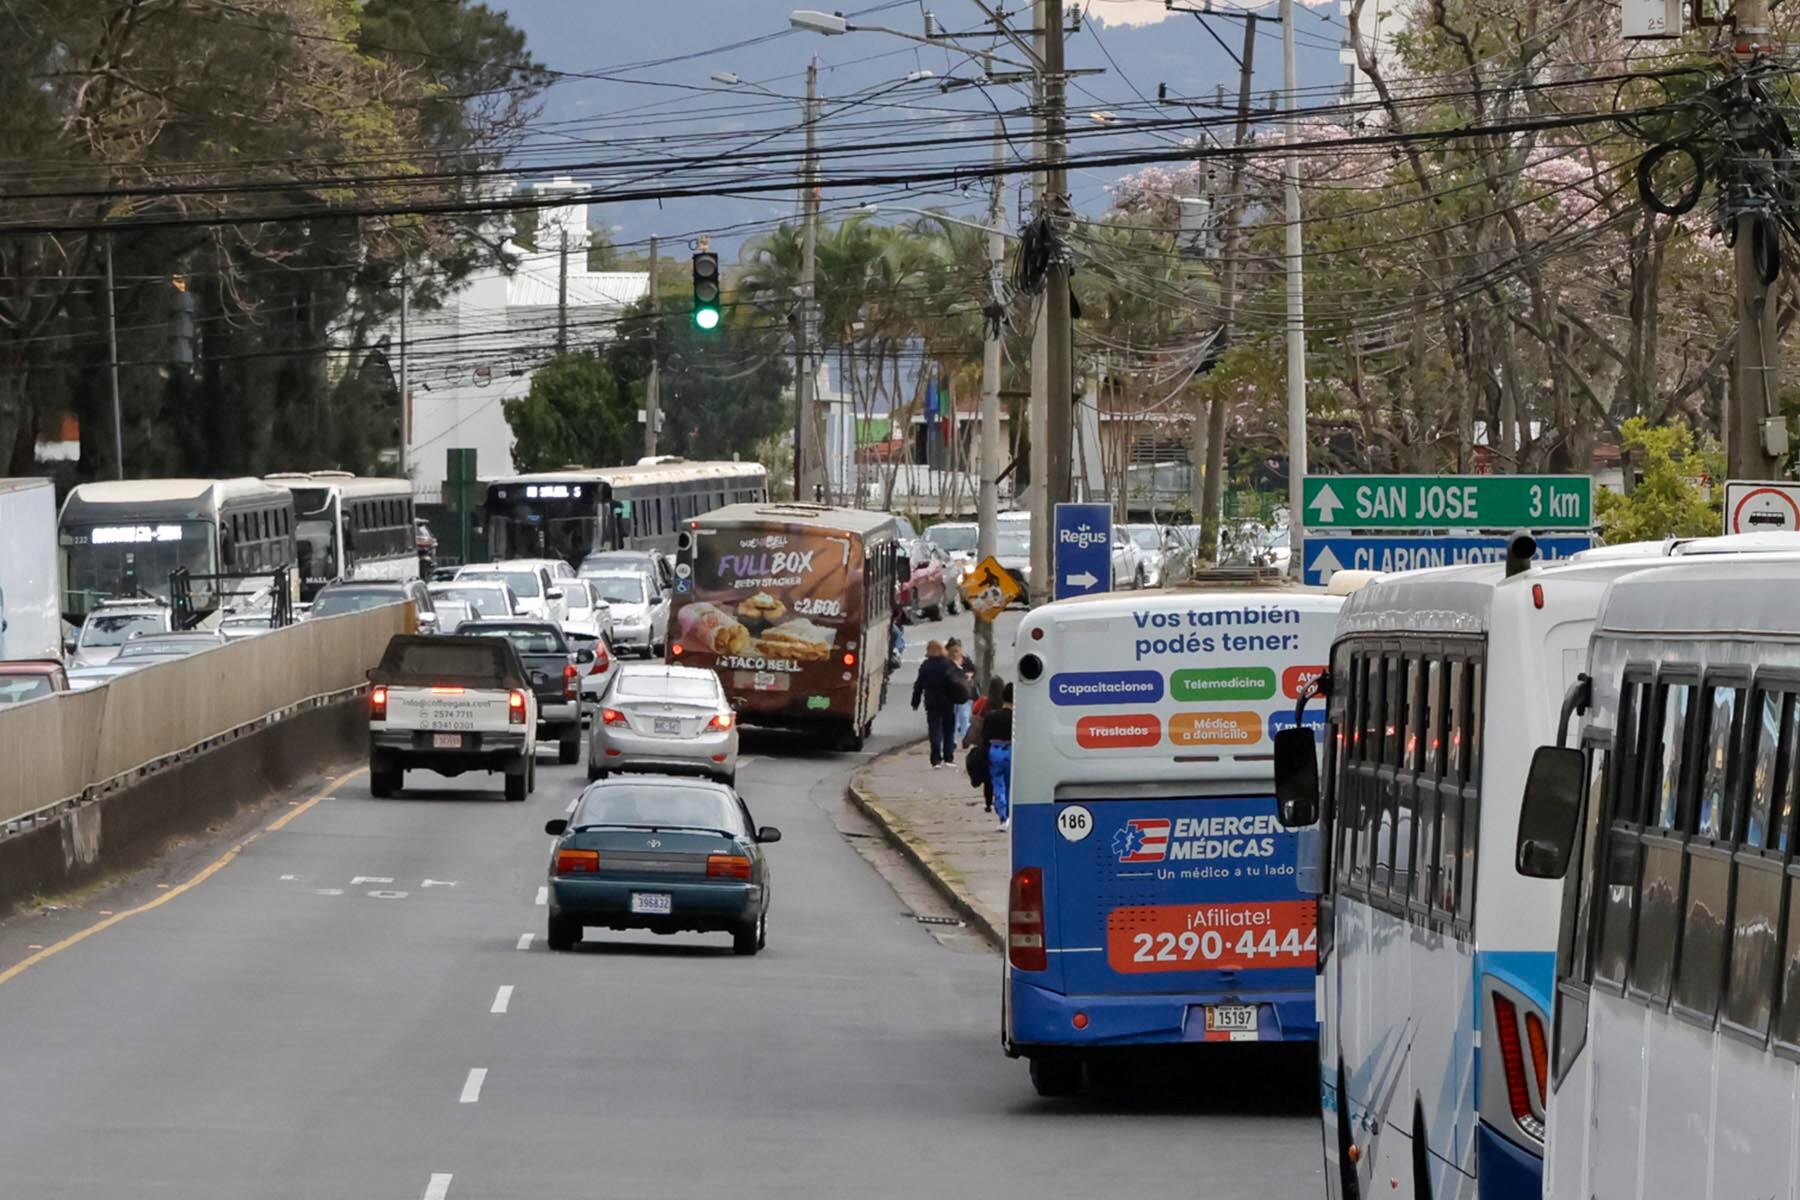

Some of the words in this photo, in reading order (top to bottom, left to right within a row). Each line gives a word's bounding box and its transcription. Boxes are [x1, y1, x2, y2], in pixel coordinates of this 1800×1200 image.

[1356, 485, 1406, 518] SAN
[1415, 486, 1478, 519] JOSE
[1529, 484, 1543, 518] 3
[1550, 485, 1580, 518] km
[1060, 529, 1106, 548] Regus
[717, 552, 770, 577] FULL
[771, 549, 814, 575] BOX
[1354, 547, 1445, 572] CLARION
[1133, 610, 1181, 629] Vos
[1187, 604, 1300, 628] también
[1135, 633, 1215, 661] podés
[1222, 633, 1299, 652] tener:
[729, 656, 766, 669] TACO
[767, 658, 803, 672] BELL
[1058, 680, 1154, 696] Capacitaciones
[1184, 676, 1266, 690] Telemedicina
[1089, 724, 1149, 738] Traslados
[1194, 717, 1238, 730] Médico
[1183, 731, 1191, 740] a
[1193, 727, 1248, 740] domicilio
[1060, 814, 1086, 829] 186
[1174, 815, 1319, 837] EMERGEN
[1169, 837, 1275, 860] MÉDICAS
[1157, 869, 1175, 880] Un
[1181, 866, 1229, 878] médico
[1234, 869, 1241, 877] a
[1247, 866, 1260, 876] tu
[1265, 864, 1295, 876] lado
[1186, 908, 1271, 930] ¡Afiliate!
[1219, 1010, 1252, 1025] 15197
